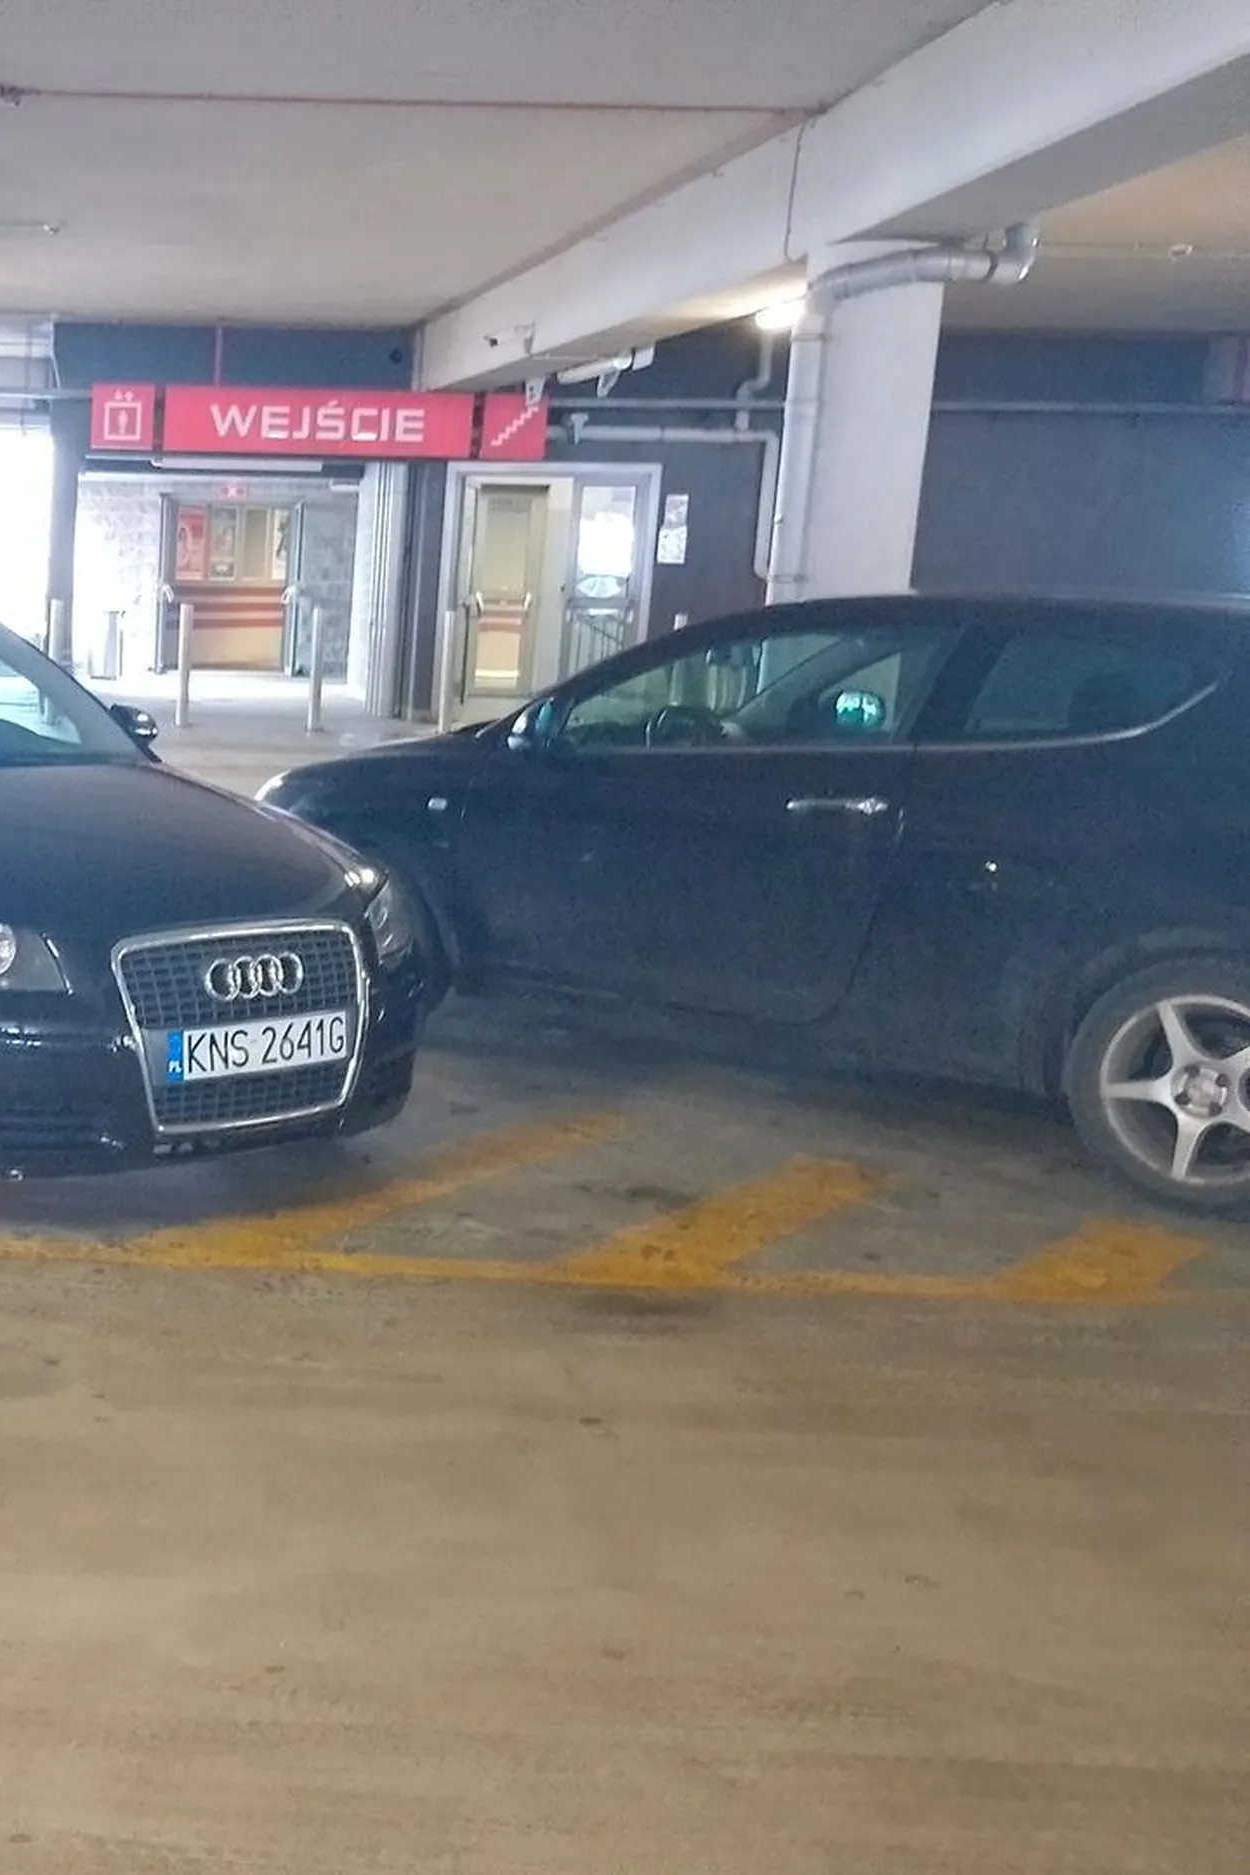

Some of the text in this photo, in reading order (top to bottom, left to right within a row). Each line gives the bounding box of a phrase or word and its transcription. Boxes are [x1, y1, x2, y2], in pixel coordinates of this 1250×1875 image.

[209, 399, 425, 443] WEJŚCIE
[168, 1060, 183, 1074] PL
[187, 1016, 345, 1074] KNS 2641G
